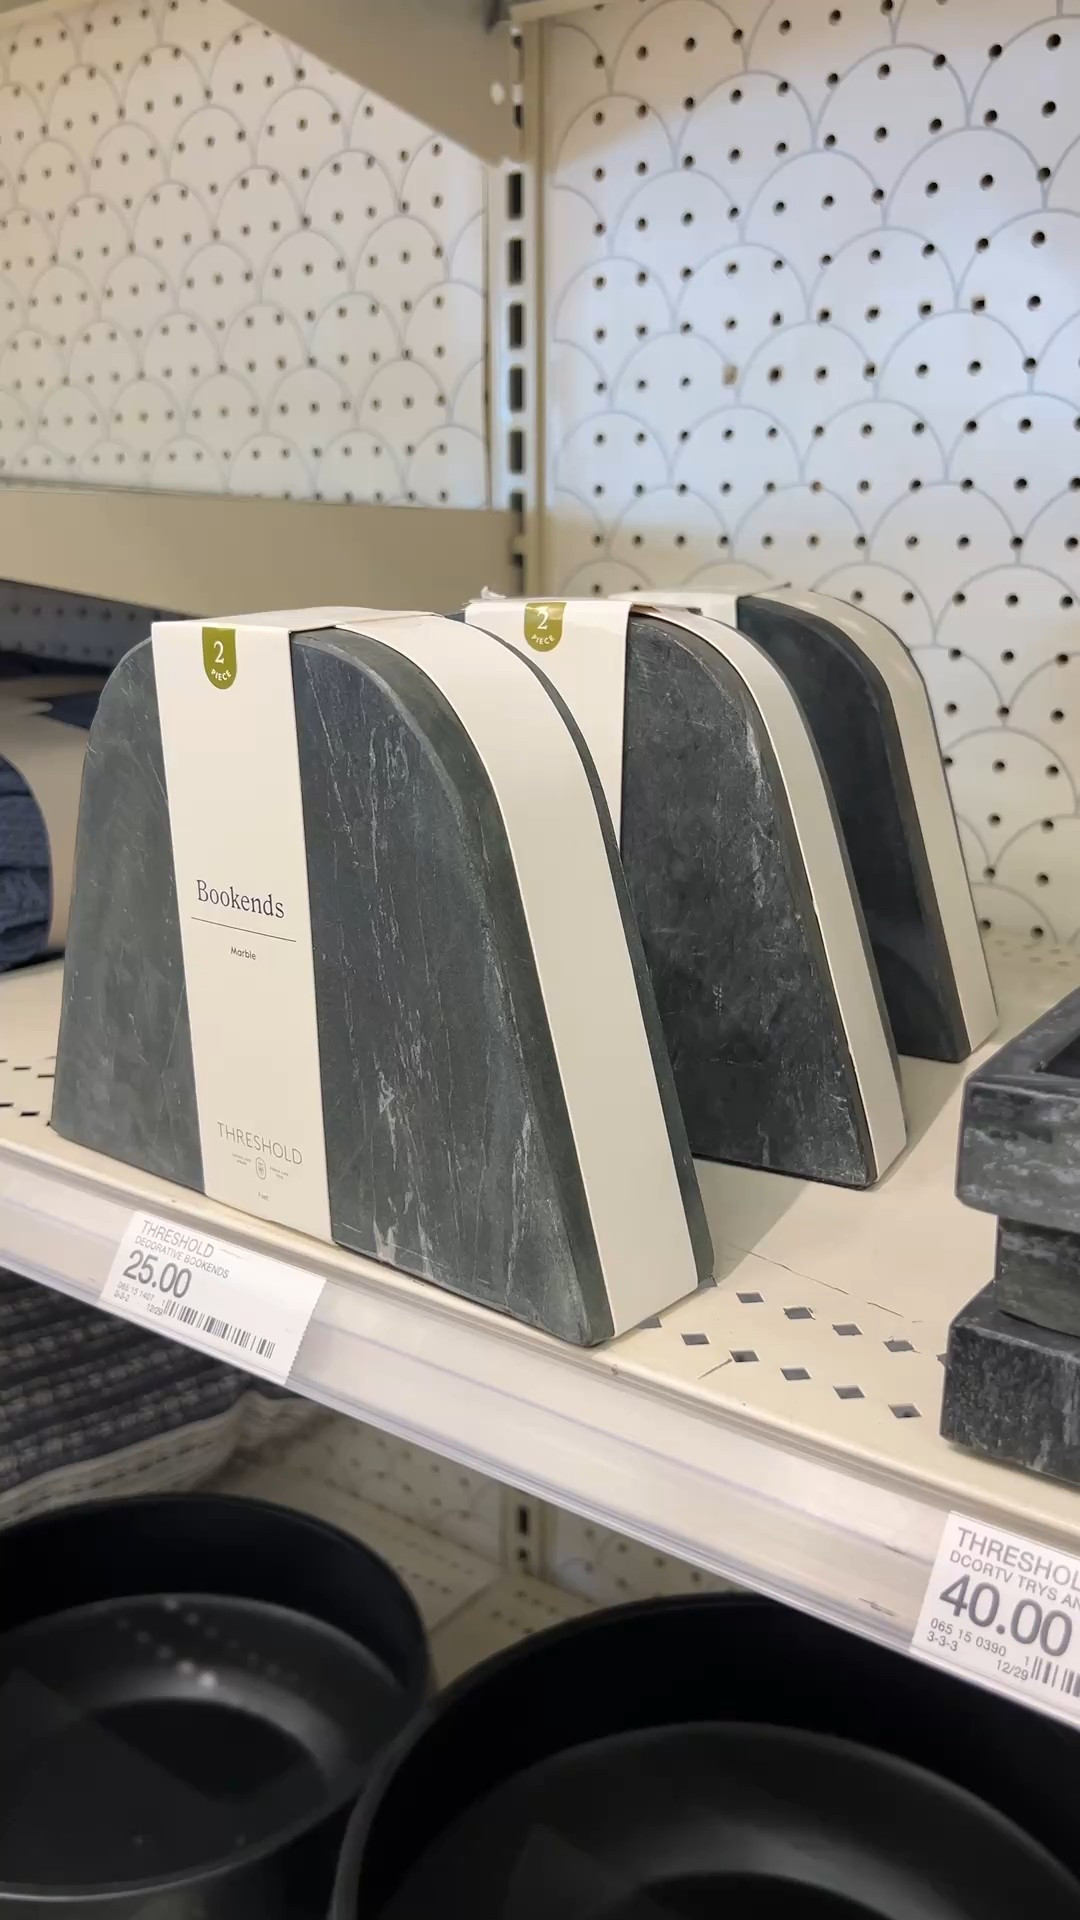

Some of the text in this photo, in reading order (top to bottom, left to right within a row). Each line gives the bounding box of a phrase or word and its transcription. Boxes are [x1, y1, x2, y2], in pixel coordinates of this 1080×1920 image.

[537, 605, 549, 630] 2
[213, 640, 225, 664] 2
[531, 634, 555, 645] PIECE
[211, 668, 232, 681] PIECE
[196, 879, 285, 919] Bookends
[230, 946, 256, 960] Marble
[217, 1121, 303, 1165] THRESHOLD
[135, 1235, 230, 1279] DECORATIVE BOOKENDS
[141, 1219, 215, 1258] THRESHOLD
[123, 1249, 192, 1299] 25.00
[950, 1549, 1014, 1583] DCORTV
[1018, 1574, 1058, 1601] TRYS
[957, 1526, 1080, 1593] THRESHOL
[939, 1573, 1073, 1657] 40.00
[927, 1631, 958, 1652] 3-3-3
[930, 1617, 1007, 1657] 065 15 0390
[996, 1659, 1029, 1681] 12/29
